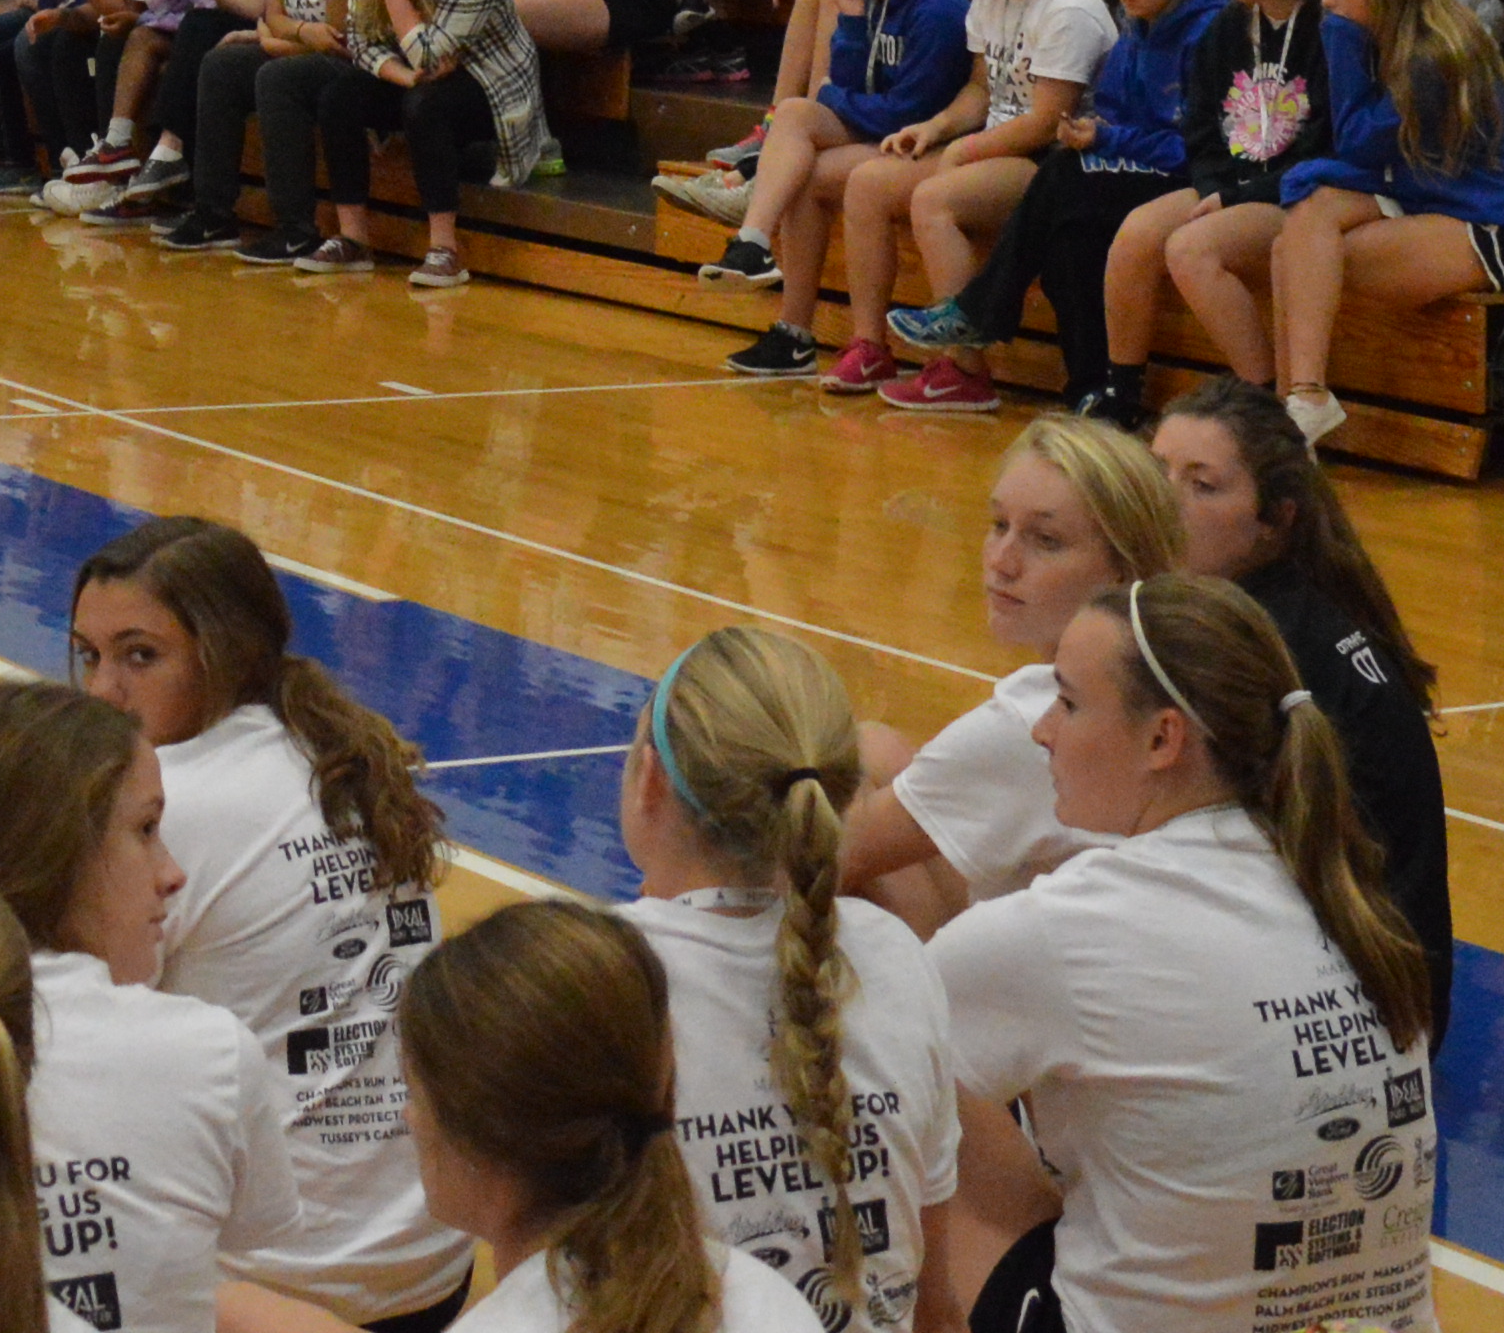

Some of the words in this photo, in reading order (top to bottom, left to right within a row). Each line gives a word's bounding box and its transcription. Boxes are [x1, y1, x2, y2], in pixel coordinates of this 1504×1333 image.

[1254, 989, 1342, 1022] THANK
[1292, 1034, 1386, 1078] LEVEL
[678, 1104, 777, 1141] THANK
[852, 1093, 900, 1116] FOR
[67, 1156, 130, 1184] FOR
[712, 1161, 823, 1203] LEVEL
[59, 1190, 101, 1217] US
[1308, 1208, 1365, 1236] ELECTION
[45, 1216, 118, 1257] UP!
